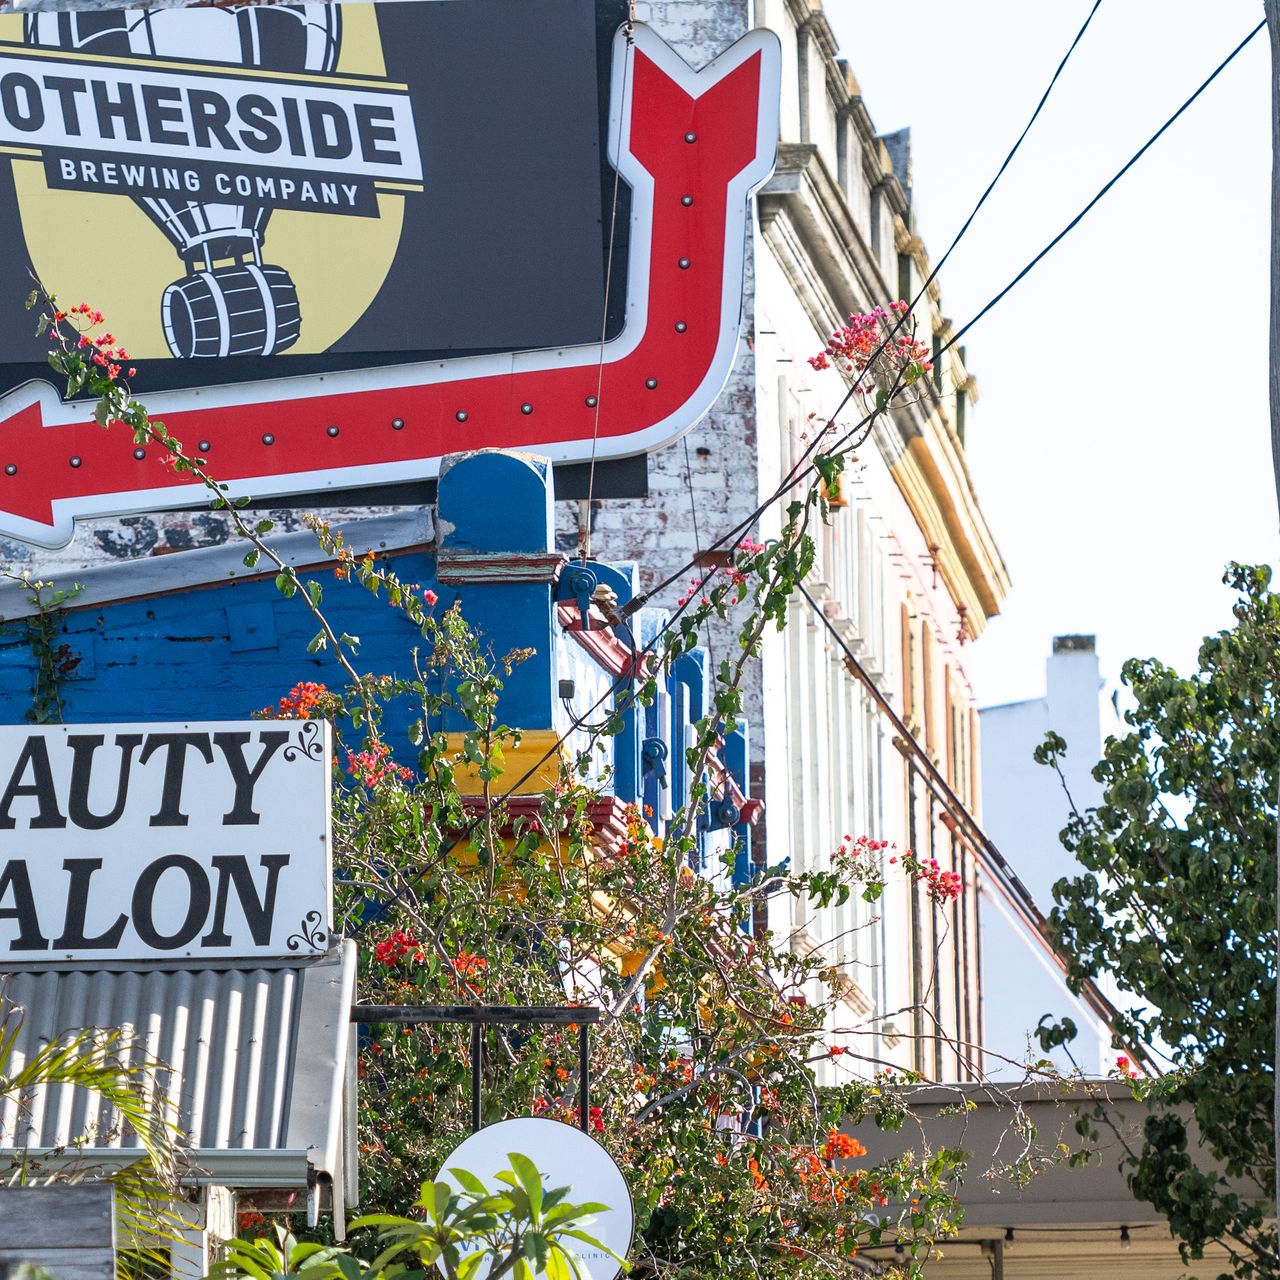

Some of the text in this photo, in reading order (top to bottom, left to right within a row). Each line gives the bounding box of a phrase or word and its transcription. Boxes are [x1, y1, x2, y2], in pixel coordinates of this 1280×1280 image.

[0, 71, 404, 167] OTHERSIDE
[59, 159, 359, 207] BREWING COMPANY
